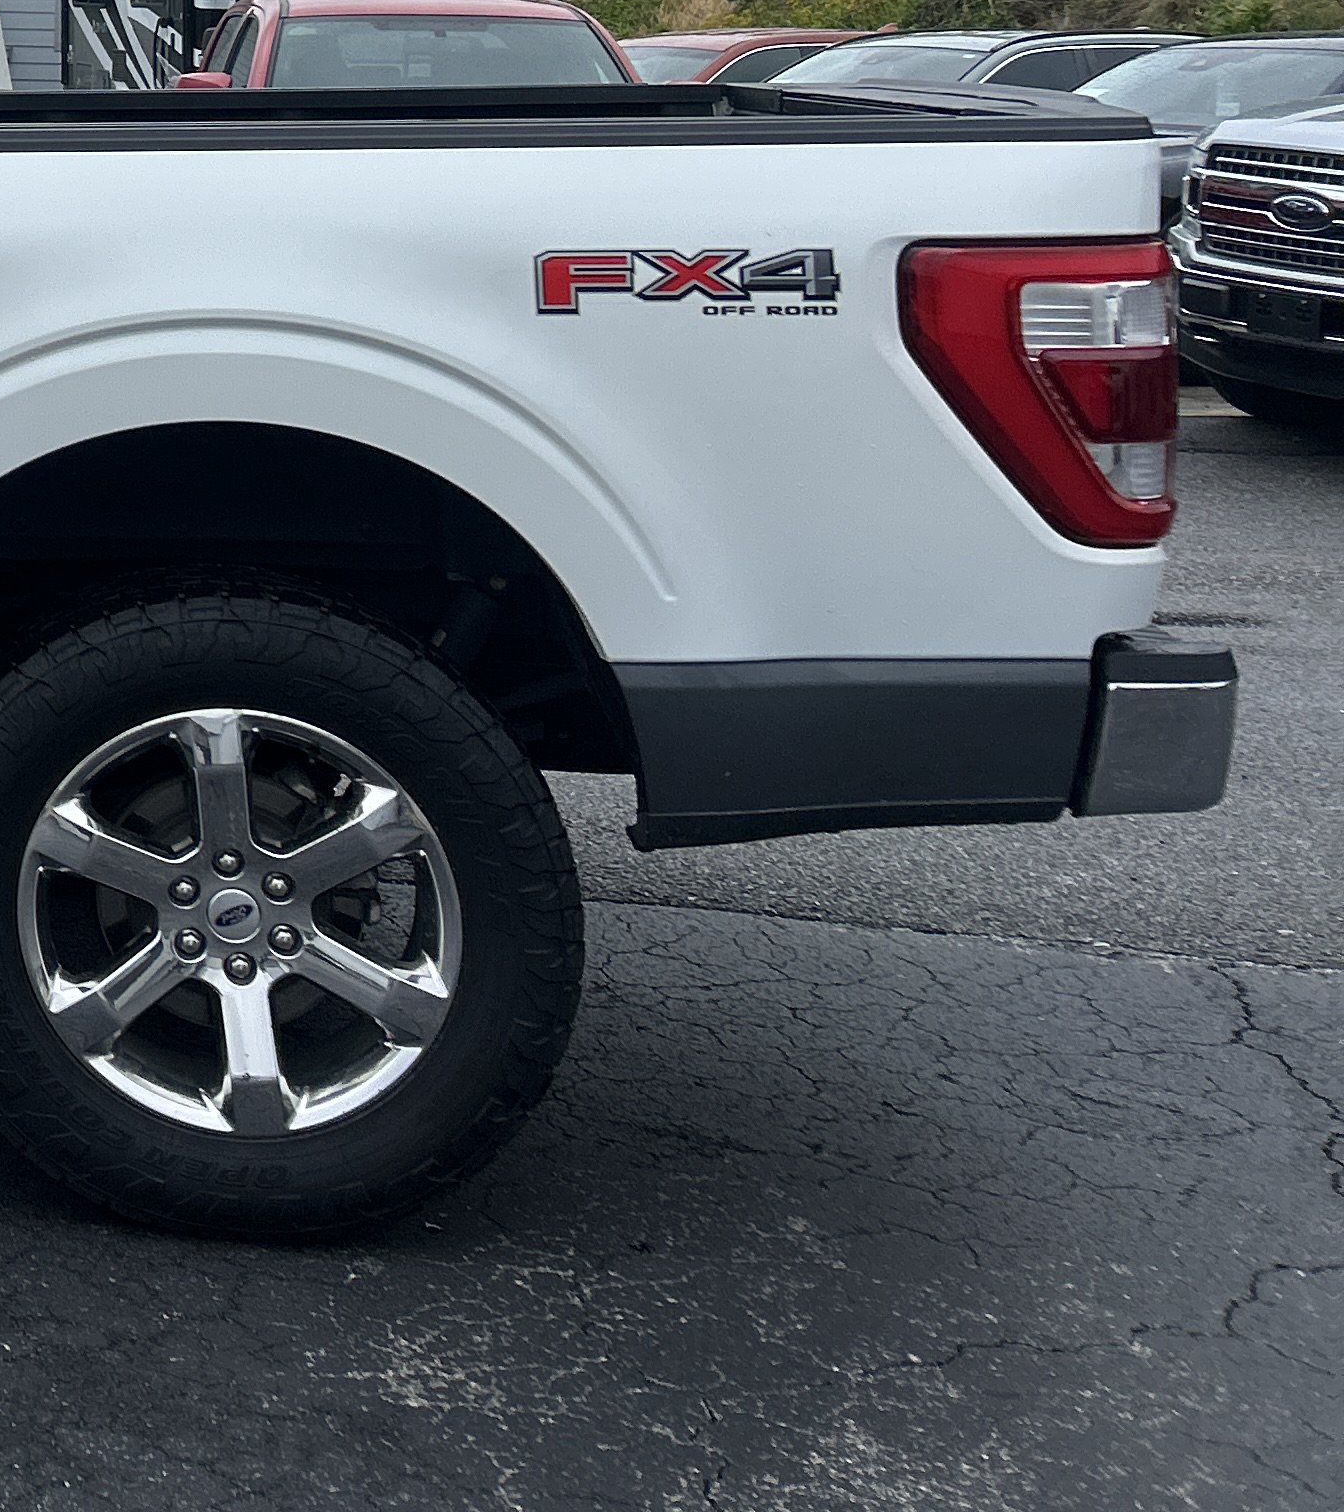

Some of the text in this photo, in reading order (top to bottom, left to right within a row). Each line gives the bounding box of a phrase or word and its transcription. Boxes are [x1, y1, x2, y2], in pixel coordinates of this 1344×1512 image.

[534, 249, 840, 315] FX4
[702, 306, 838, 316] OFF ROAD
